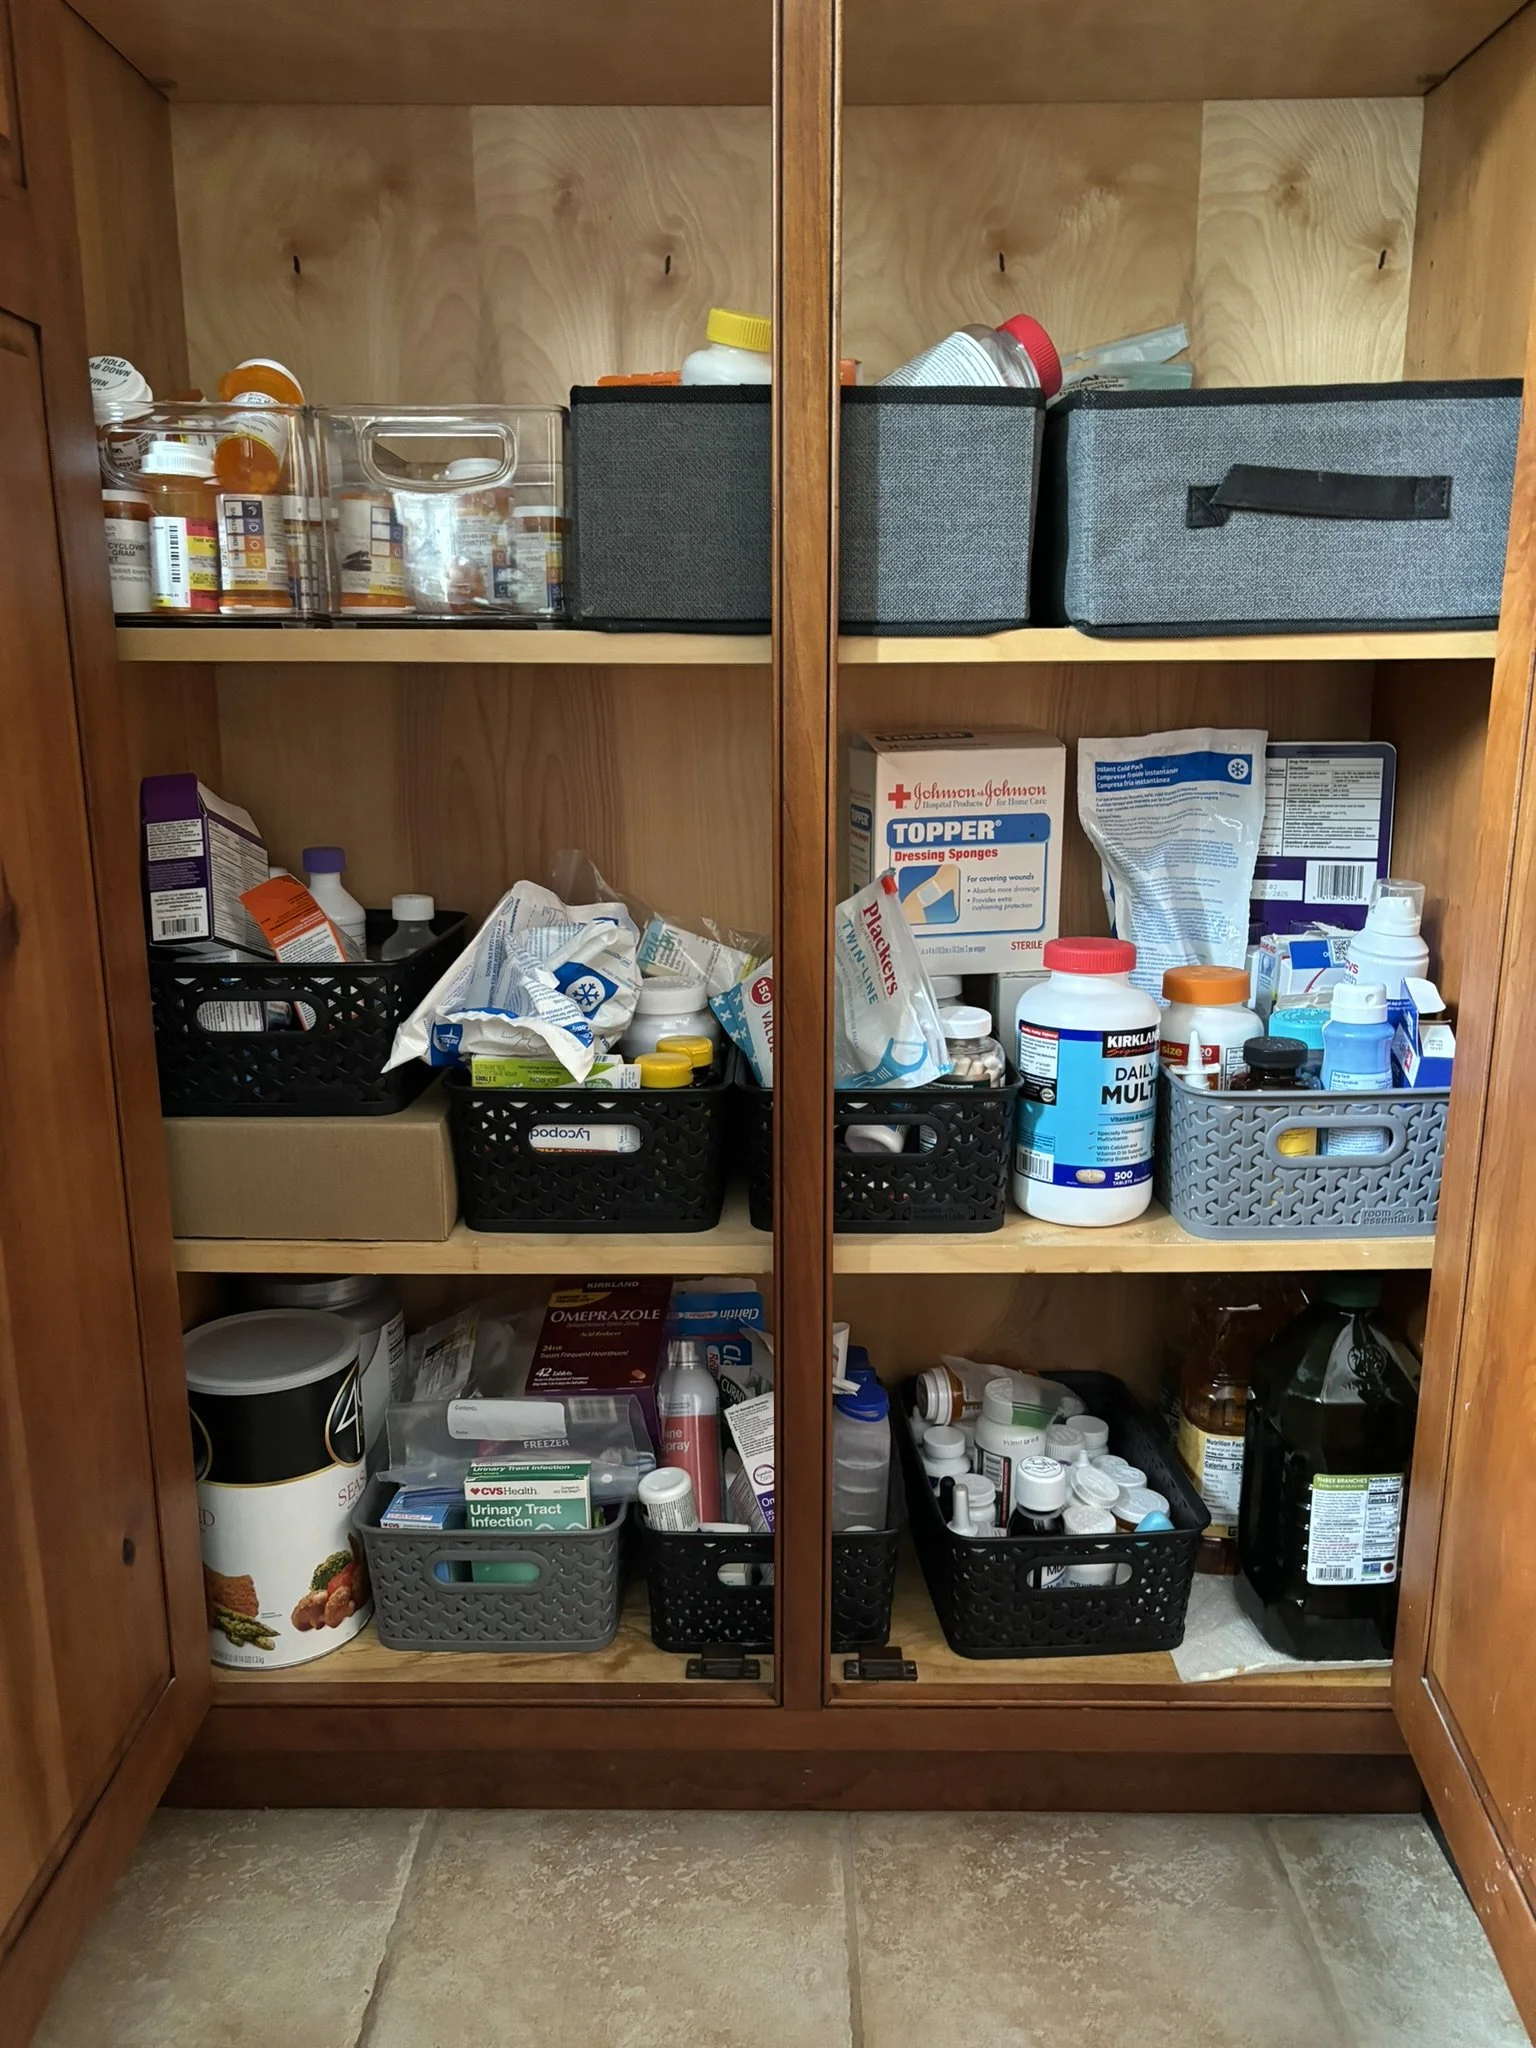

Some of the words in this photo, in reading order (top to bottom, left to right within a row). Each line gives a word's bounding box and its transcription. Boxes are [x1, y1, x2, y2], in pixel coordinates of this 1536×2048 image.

[100, 358, 126, 368] HOLD
[89, 362, 101, 370] AB
[102, 365, 132, 377] DOWN
[90, 377, 109, 387] URN
[1097, 773, 1126, 782] Compresse
[1127, 771, 1144, 779] froide
[1097, 781, 1123, 789] Compresa
[914, 782, 975, 810] Johnson
[985, 779, 1047, 807] Johnson
[923, 801, 951, 810] Hospital
[953, 799, 983, 808] Products
[996, 798, 1006, 806] for
[1008, 798, 1028, 806] Home
[895, 849, 945, 862] Dressing
[949, 848, 998, 861] Sponges
[1014, 885, 1040, 893] drainage
[863, 898, 899, 998] Plackers
[1011, 940, 1043, 950] STERILE
[842, 919, 879, 1005] TWIN-LINE
[756, 979, 773, 1002] 150
[1161, 1043, 1183, 1057] size
[1115, 1062, 1155, 1081] DAILY
[1110, 1114, 1133, 1123] Vitamins
[530, 1127, 591, 1142] Lycopod
[1098, 1129, 1121, 1137] Specially
[1114, 1170, 1133, 1180] 500
[1363, 1209, 1391, 1217] room
[1363, 1214, 1415, 1224] essentials
[586, 1280, 639, 1289] KIRKLAND
[550, 1308, 660, 1323] OMEPRAZOLE
[719, 1308, 760, 1320] Claritin
[561, 1351, 591, 1359] Frequent
[535, 1367, 552, 1377] 42
[664, 1428, 682, 1437] ine
[523, 1438, 570, 1449] FREEZER
[1206, 1438, 1231, 1447] Nutrition
[1204, 1461, 1227, 1470] Calories
[1387, 1494, 1398, 1503] 120
[470, 1504, 522, 1518] Urinary
[526, 1504, 562, 1515] Tract
[471, 1516, 533, 1528] Infection
